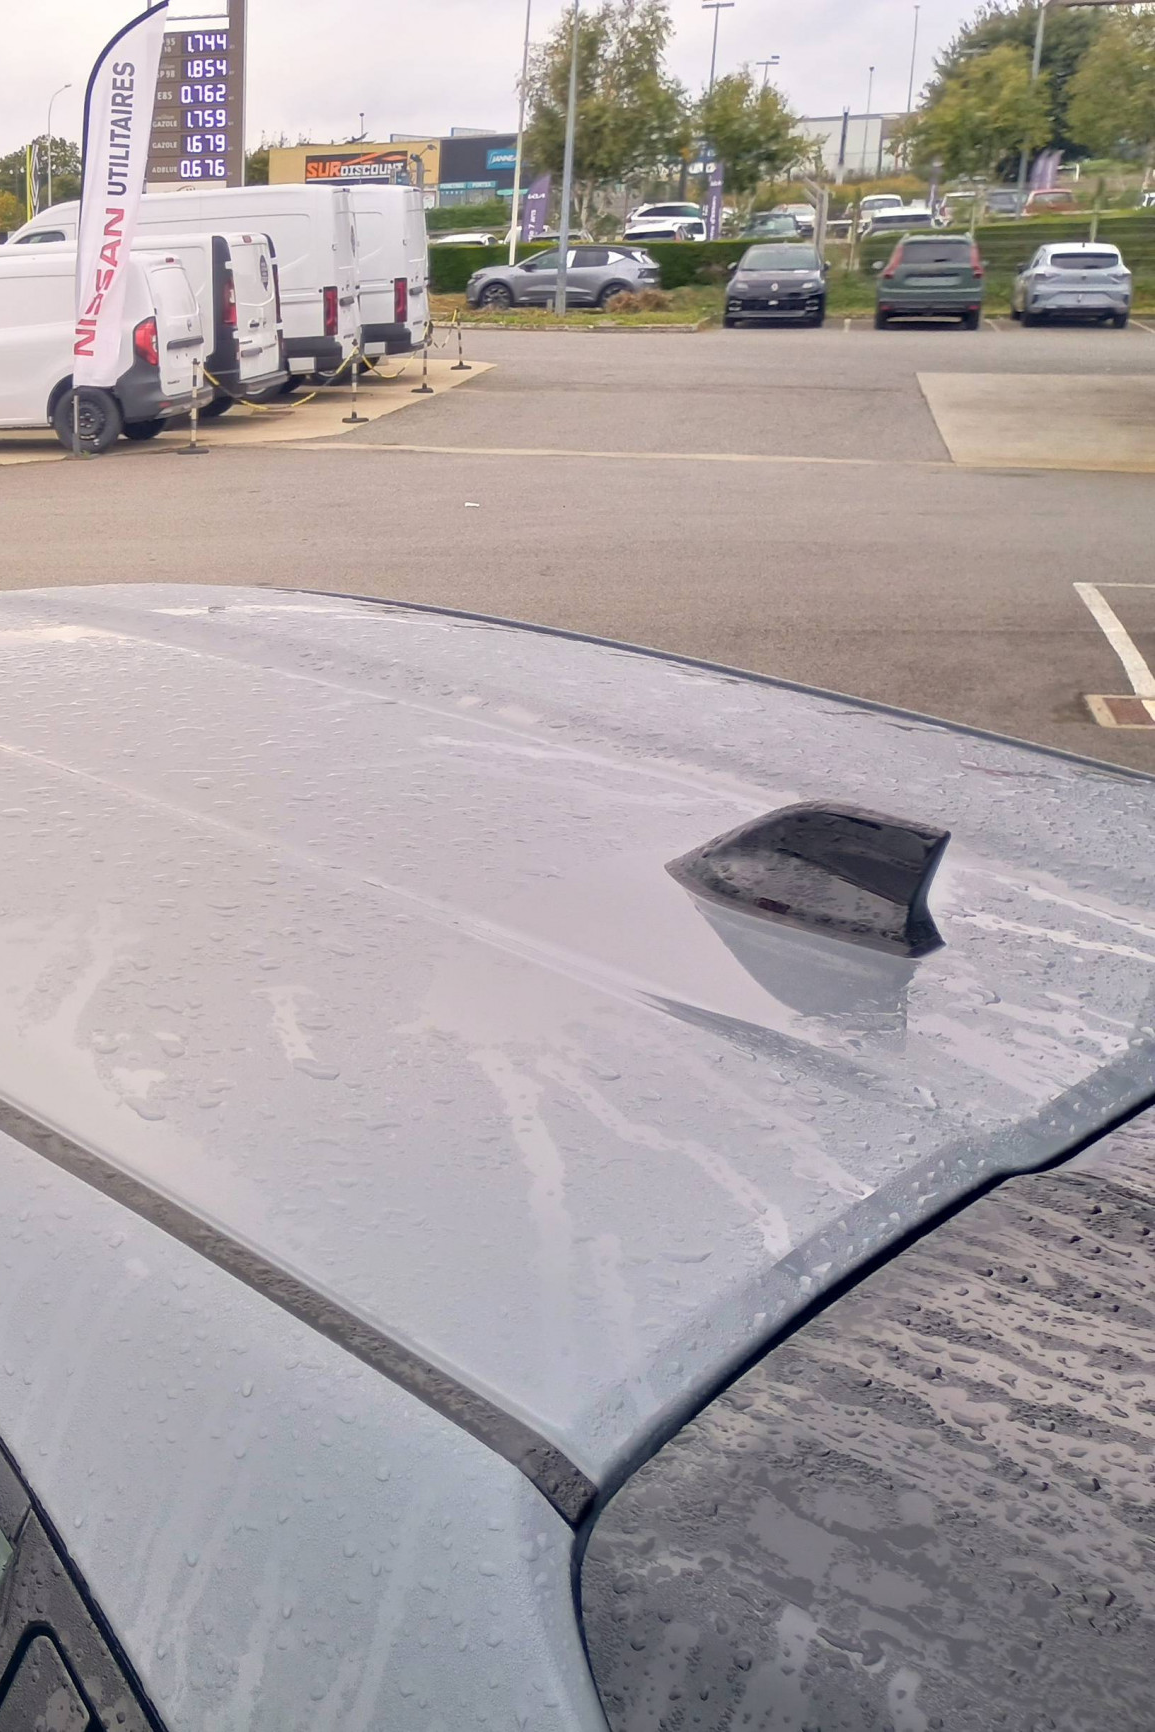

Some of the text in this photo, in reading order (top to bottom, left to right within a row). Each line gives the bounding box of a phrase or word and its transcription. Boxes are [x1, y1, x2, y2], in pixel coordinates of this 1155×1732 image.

[157, 91, 173, 100] E85
[181, 84, 226, 103] 0.762
[152, 120, 178, 128] GAZOLE
[180, 159, 225, 178] 0.676
[74, 62, 136, 357] NISSAN UTILITAIRES
